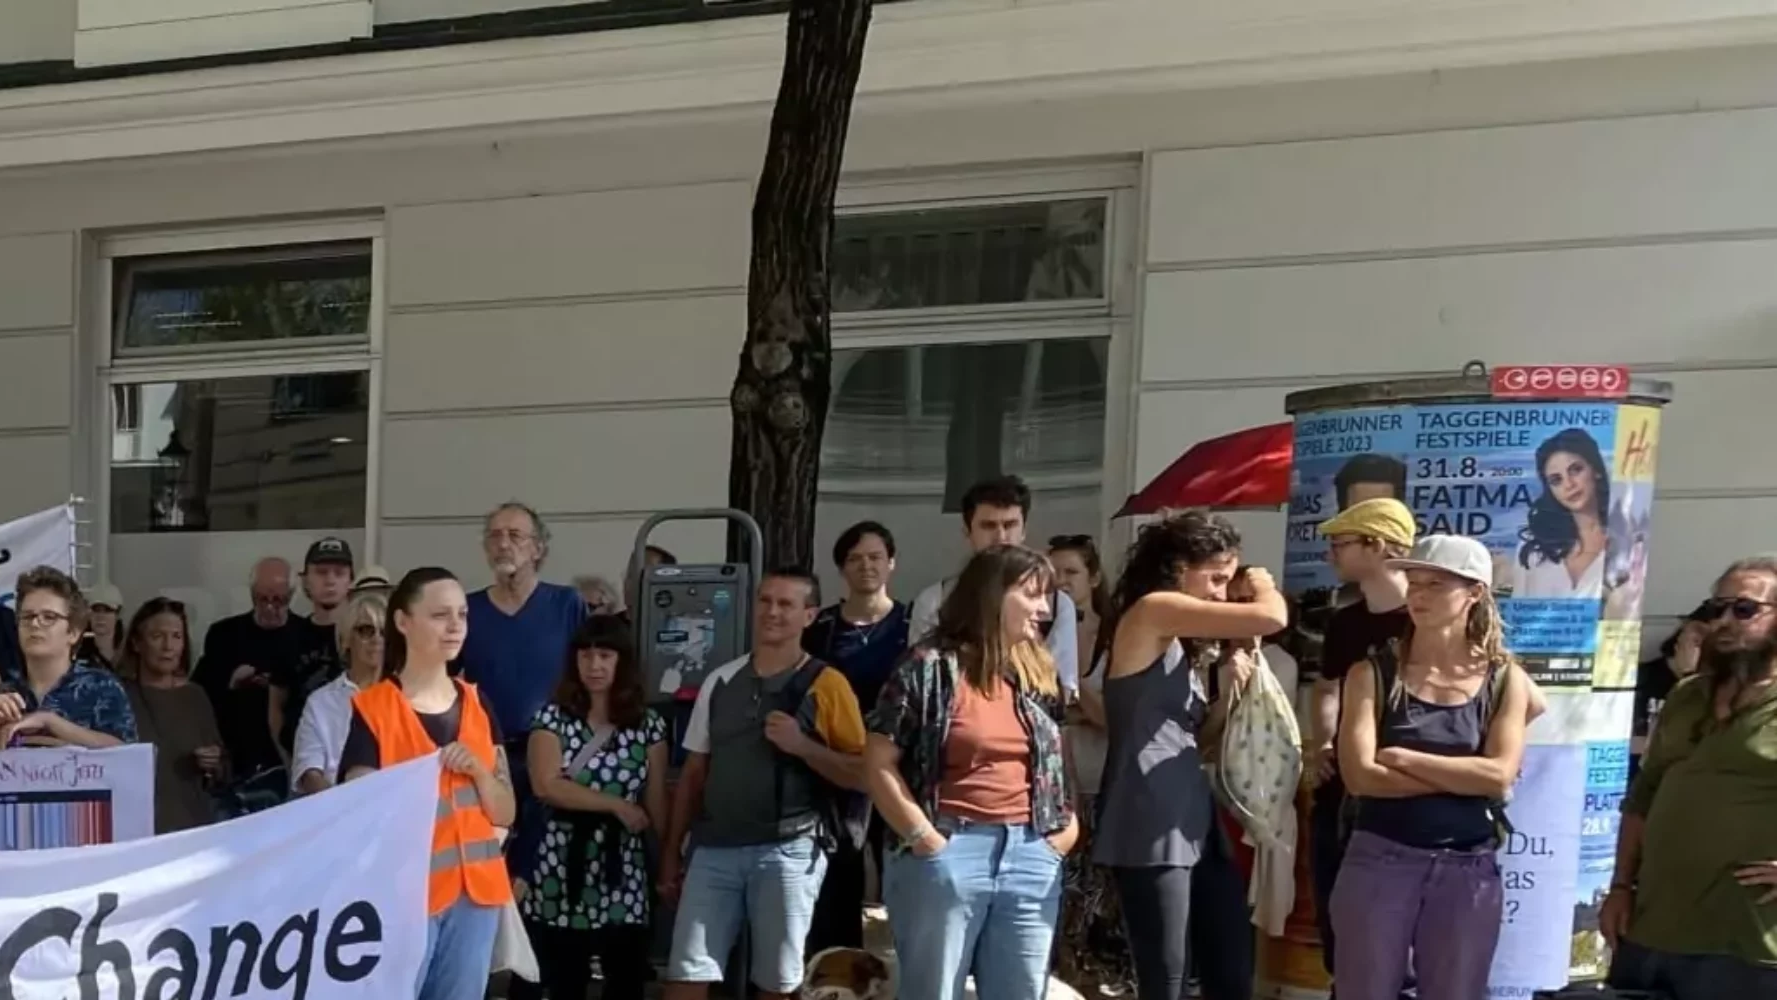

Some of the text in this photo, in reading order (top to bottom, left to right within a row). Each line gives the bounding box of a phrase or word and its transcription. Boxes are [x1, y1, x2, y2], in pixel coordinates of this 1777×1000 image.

[1417, 409, 1611, 430] TAGGENBRUNNER
[1338, 436, 1372, 452] 2023
[1415, 430, 1531, 449] FESTSPIELE
[1415, 456, 1485, 479] 31.8.
[1412, 483, 1534, 510] FATMA
[1414, 512, 1493, 537] SAID
